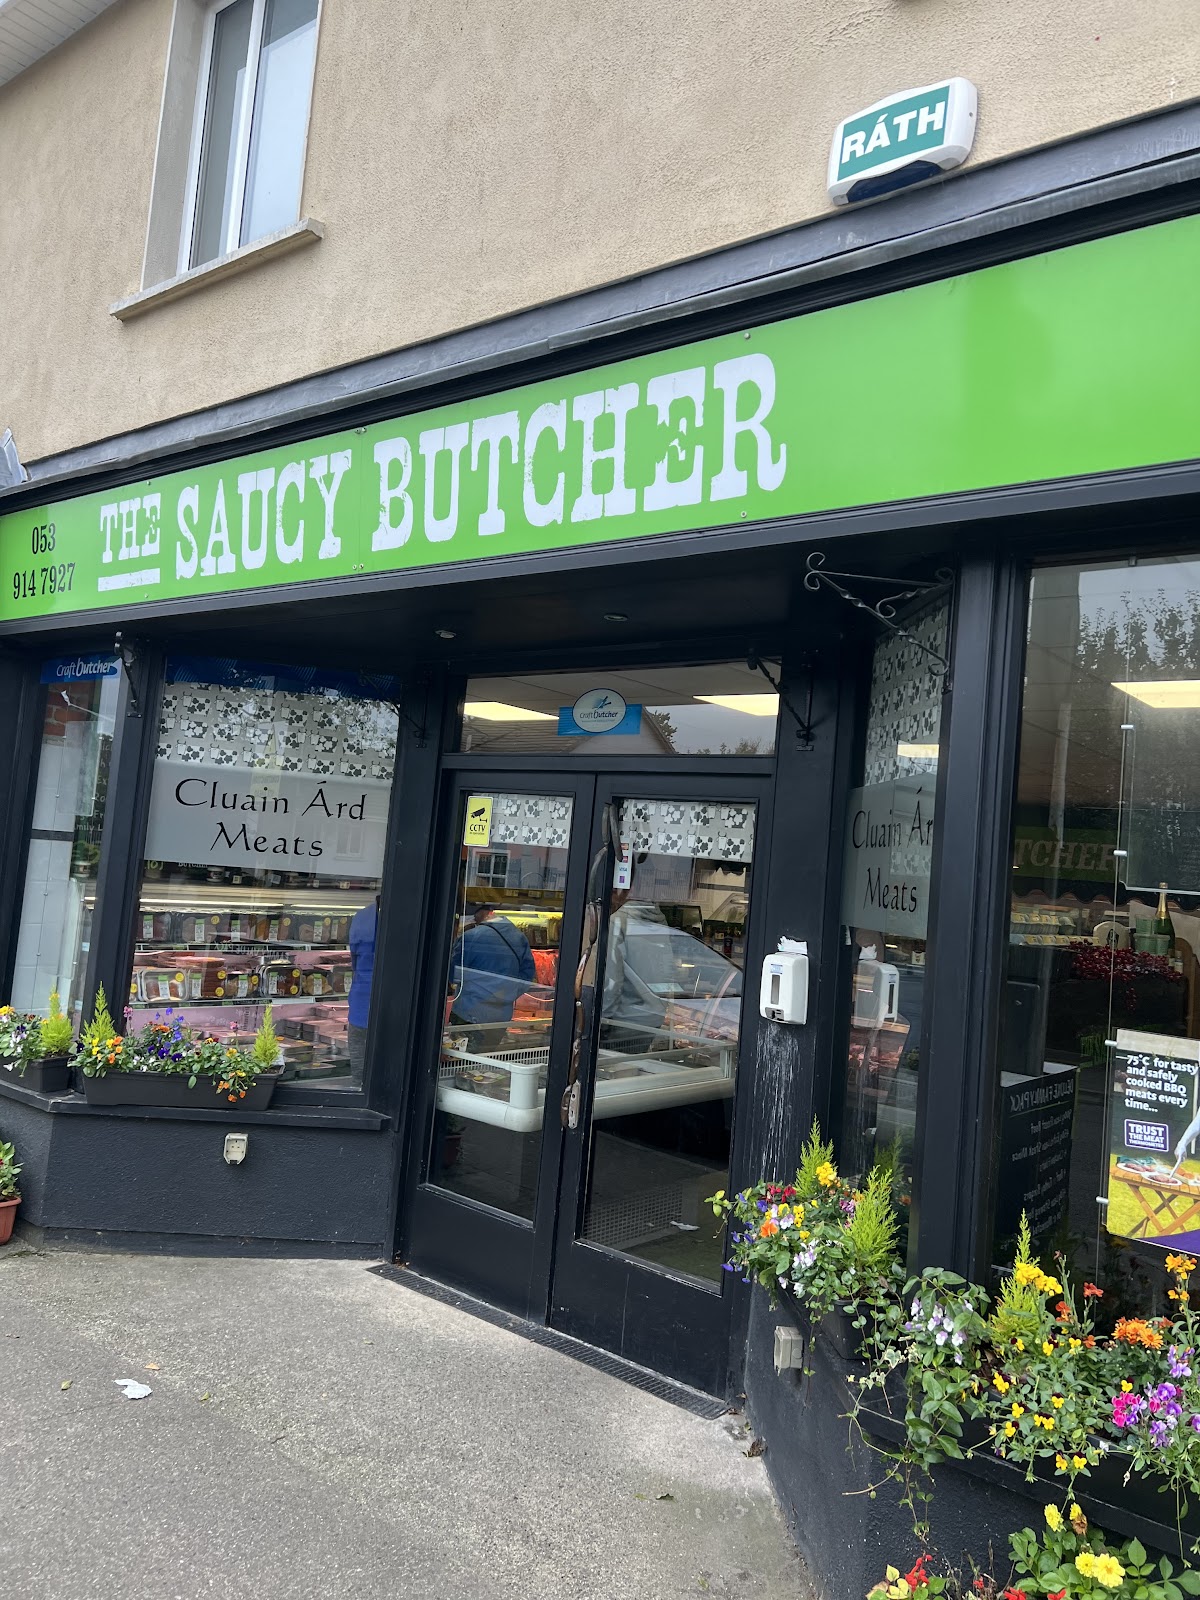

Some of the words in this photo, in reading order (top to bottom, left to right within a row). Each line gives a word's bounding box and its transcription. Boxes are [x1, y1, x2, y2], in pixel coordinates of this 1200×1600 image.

[841, 101, 946, 164] RÁTH
[99, 492, 161, 563] THE
[175, 448, 353, 580] SAUCY
[371, 353, 787, 552] BUTCHER
[31, 523, 56, 555] 053
[12, 569, 37, 600] 914
[37, 562, 76, 595] 7927
[56, 661, 76, 678] Craft
[174, 778, 289, 815] Cluain
[301, 780, 366, 821] Árd
[469, 823, 486, 832] CCTV
[852, 808, 902, 849] Cluain
[906, 786, 933, 849] Ár
[210, 821, 323, 858] Meats
[863, 867, 917, 913] Meats
[1126, 1066, 1146, 1077] and
[1147, 1069, 1178, 1083] safely
[1153, 1057, 1169, 1069] for
[1171, 1060, 1198, 1076] tasty
[1125, 1077, 1162, 1091] cooked
[1163, 1083, 1187, 1097] BBQ
[1124, 1098, 1158, 1112] time...
[1125, 1088, 1157, 1101] meats
[1158, 1094, 1188, 1108] every
[1128, 1123, 1165, 1136] TRUST
[1128, 1132, 1144, 1141] THE
[1143, 1135, 1165, 1144] MEAT
